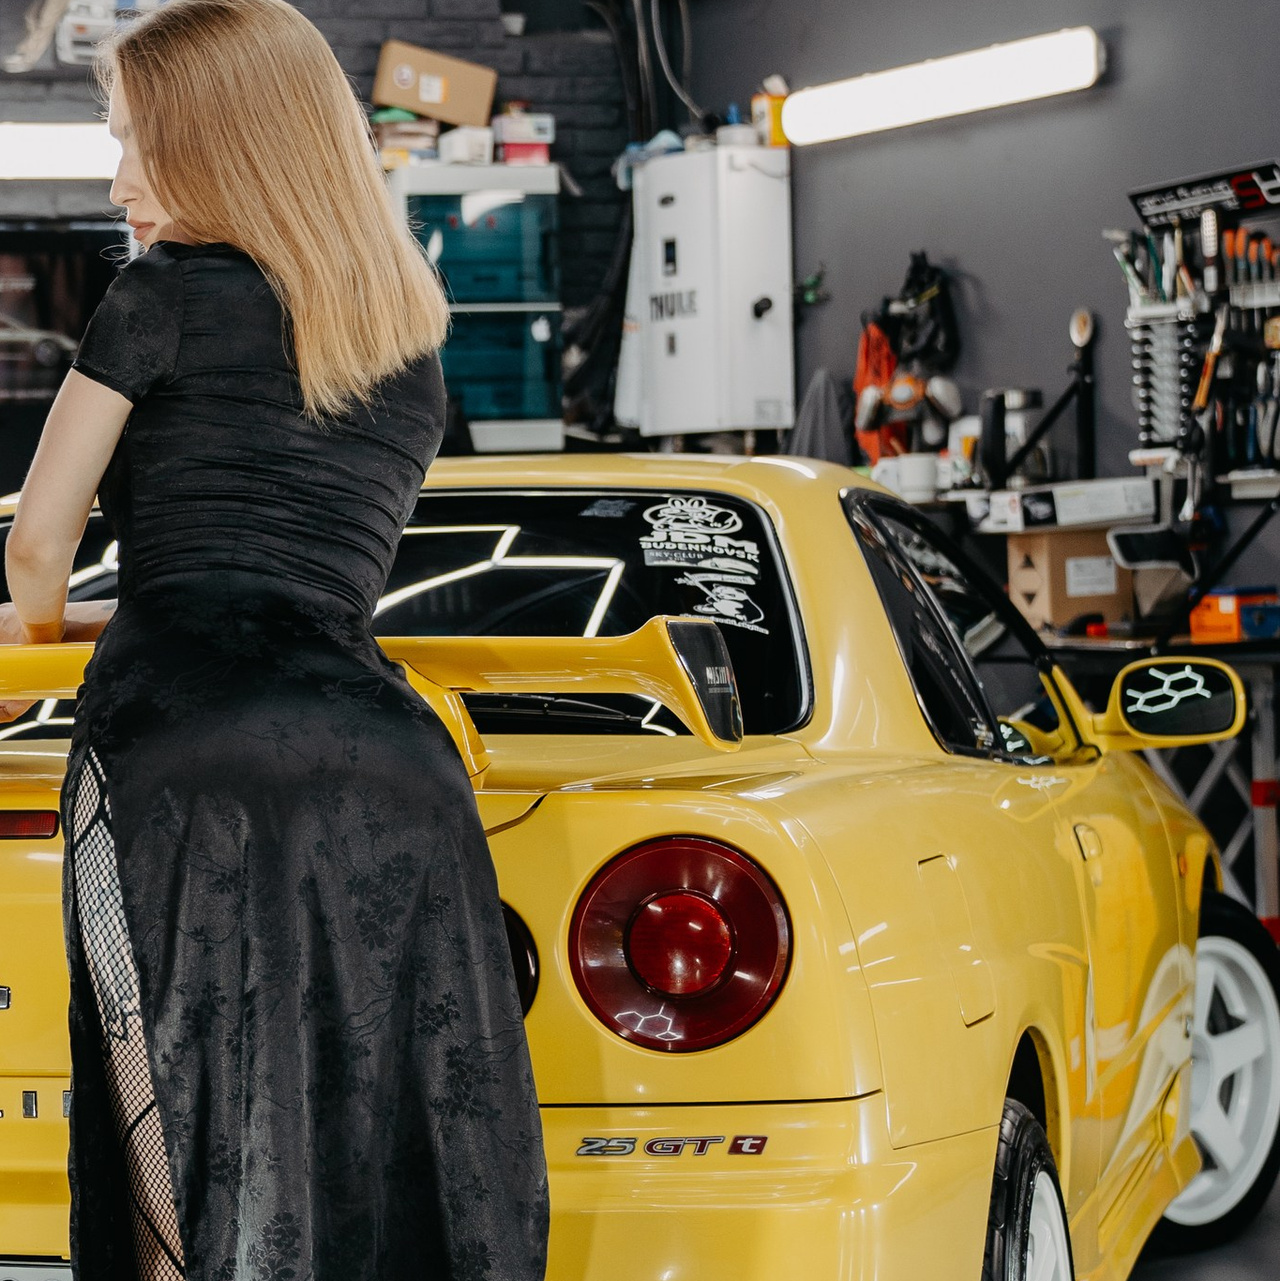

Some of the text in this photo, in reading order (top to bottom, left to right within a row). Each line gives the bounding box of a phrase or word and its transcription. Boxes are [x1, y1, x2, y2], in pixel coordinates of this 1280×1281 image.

[639, 531, 760, 555] JDM
[639, 541, 760, 563] BUDENNOVSK
[576, 1137, 638, 1156] 25
[644, 1136, 725, 1156] GT
